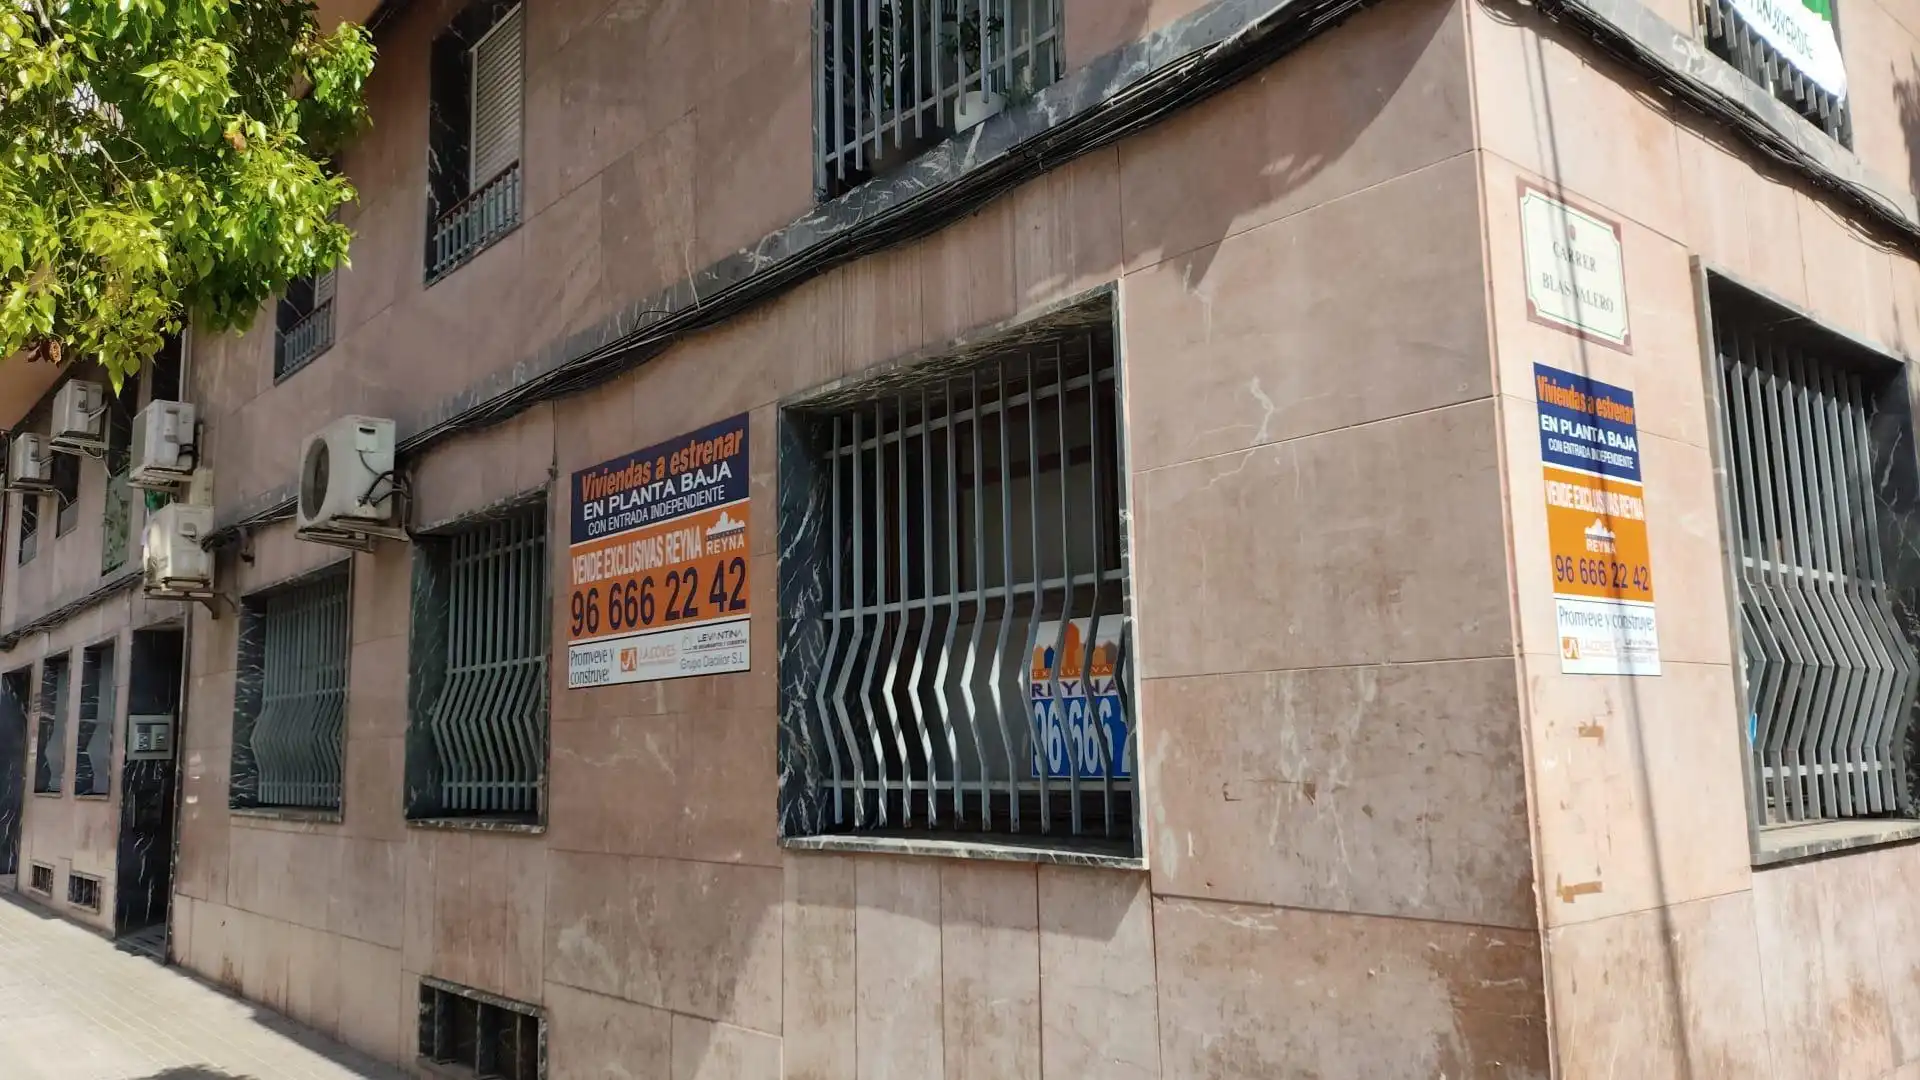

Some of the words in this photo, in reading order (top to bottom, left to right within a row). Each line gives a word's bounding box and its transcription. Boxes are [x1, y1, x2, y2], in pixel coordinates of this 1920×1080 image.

[1553, 241, 1596, 272] CARRER
[1542, 272, 1571, 296] BLAS
[1573, 284, 1614, 313] VALERO
[1537, 374, 1586, 412] Viviendas
[1587, 395, 1594, 414] a
[1595, 396, 1635, 425] estrenar
[1541, 414, 1558, 433] EN
[1560, 419, 1606, 445] PLANTA
[1607, 430, 1637, 452] BAJA
[582, 459, 651, 502] Viviendas
[655, 456, 665, 480] a
[670, 428, 744, 475] estrenar
[1548, 438, 1563, 452] CON
[1563, 440, 1591, 459] ENTRADA
[1590, 448, 1634, 469] INDEPENDIENTE
[583, 499, 604, 521] EN
[609, 478, 676, 517] PLANTA
[681, 461, 732, 491] BAJA
[588, 520, 606, 536] CON
[608, 508, 649, 531] ENTRADA
[650, 485, 725, 519] INDEPENDIENTE
[572, 550, 603, 585] VENDE
[603, 535, 664, 579] EXCLUSIVAS
[665, 525, 703, 565] REYNA
[706, 534, 745, 556] REYNA
[1586, 538, 1616, 554] REYNA
[1555, 555, 1574, 583] 96
[1579, 558, 1606, 586] 666
[1611, 562, 1628, 589] 22
[1633, 564, 1649, 591] 42
[571, 588, 599, 636] 96
[609, 576, 655, 630] 666
[665, 567, 699, 621] 22
[709, 557, 746, 612] 42
[681, 657, 701, 672] Grupo
